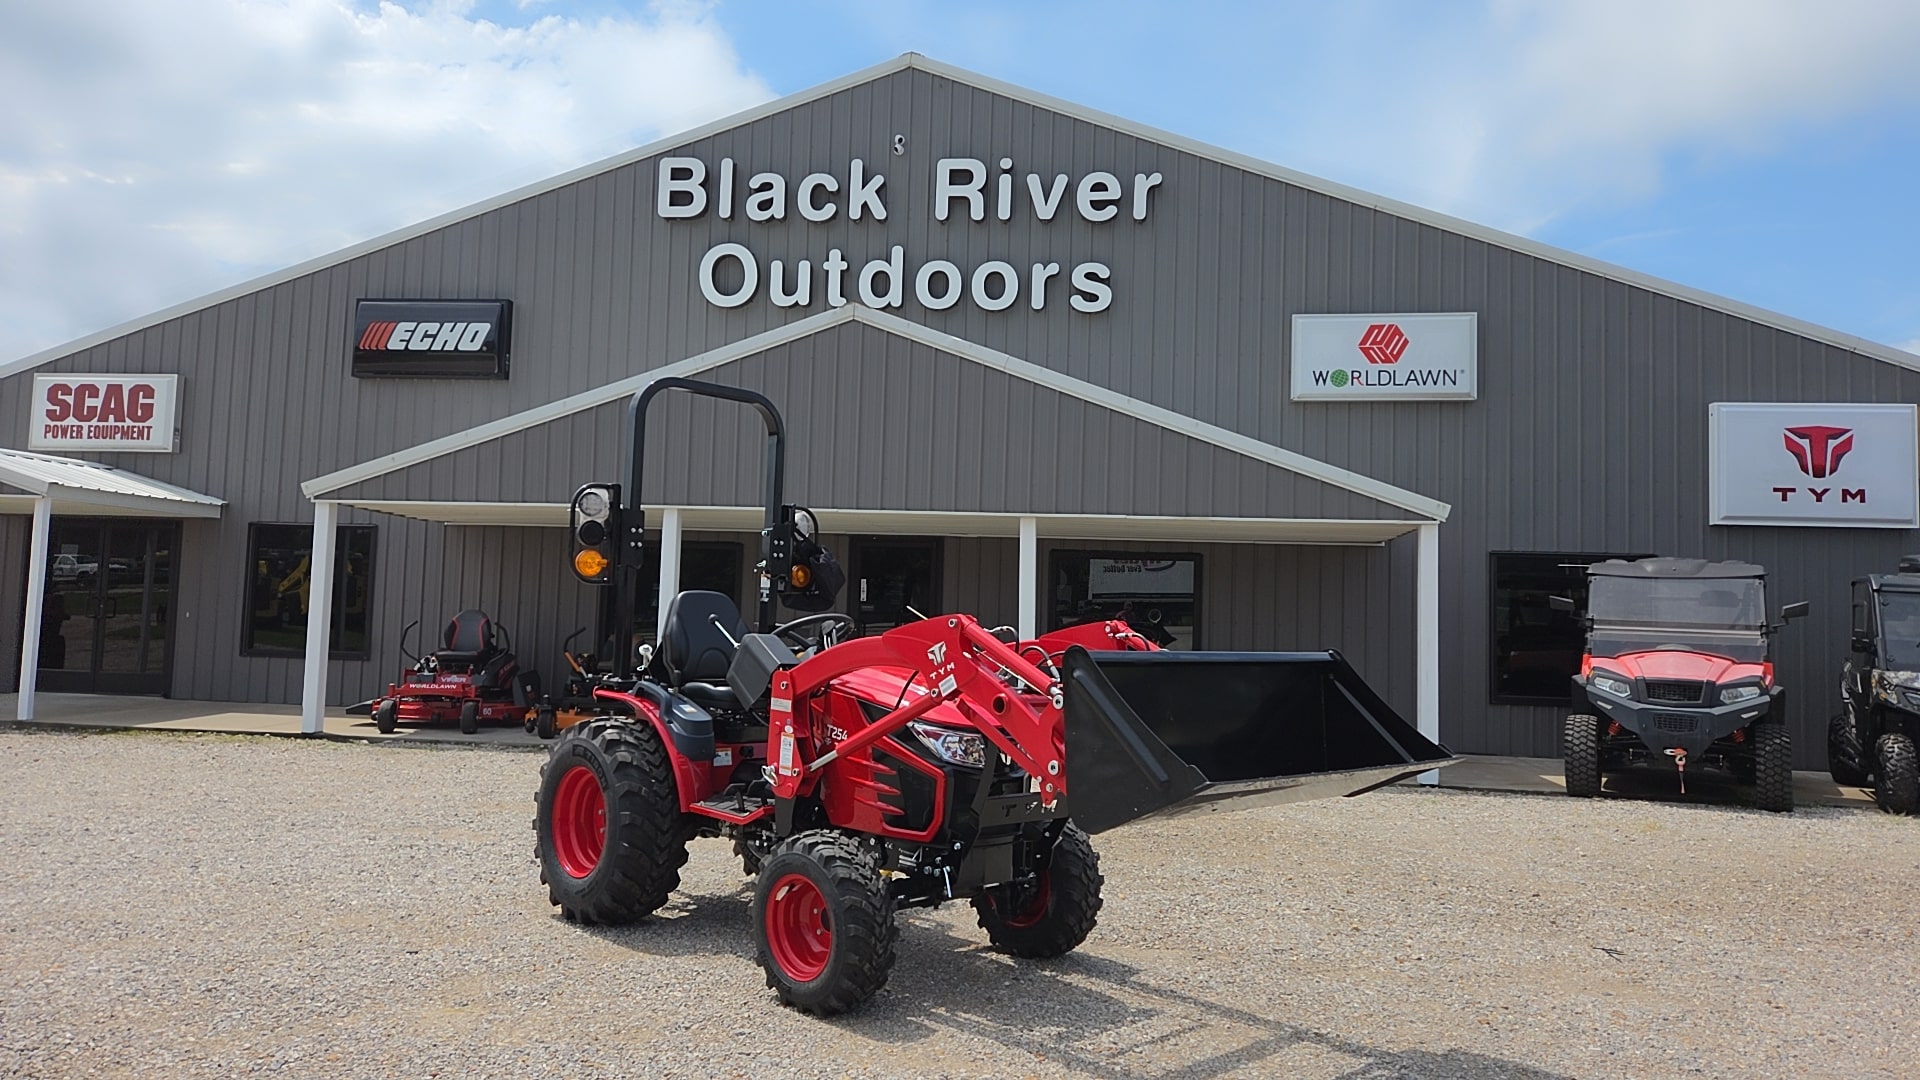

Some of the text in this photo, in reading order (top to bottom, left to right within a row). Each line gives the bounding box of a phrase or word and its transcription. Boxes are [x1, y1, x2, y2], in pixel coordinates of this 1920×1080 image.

[657, 156, 1163, 222] Black River
[699, 242, 1113, 313] Outdoors
[386, 321, 492, 351] ECHO
[45, 383, 155, 423] SCAG
[44, 424, 153, 441] POWER EQUIPMENT
[1772, 486, 1866, 504] TYM
[929, 661, 956, 680] TYM
[826, 723, 848, 741] T254
